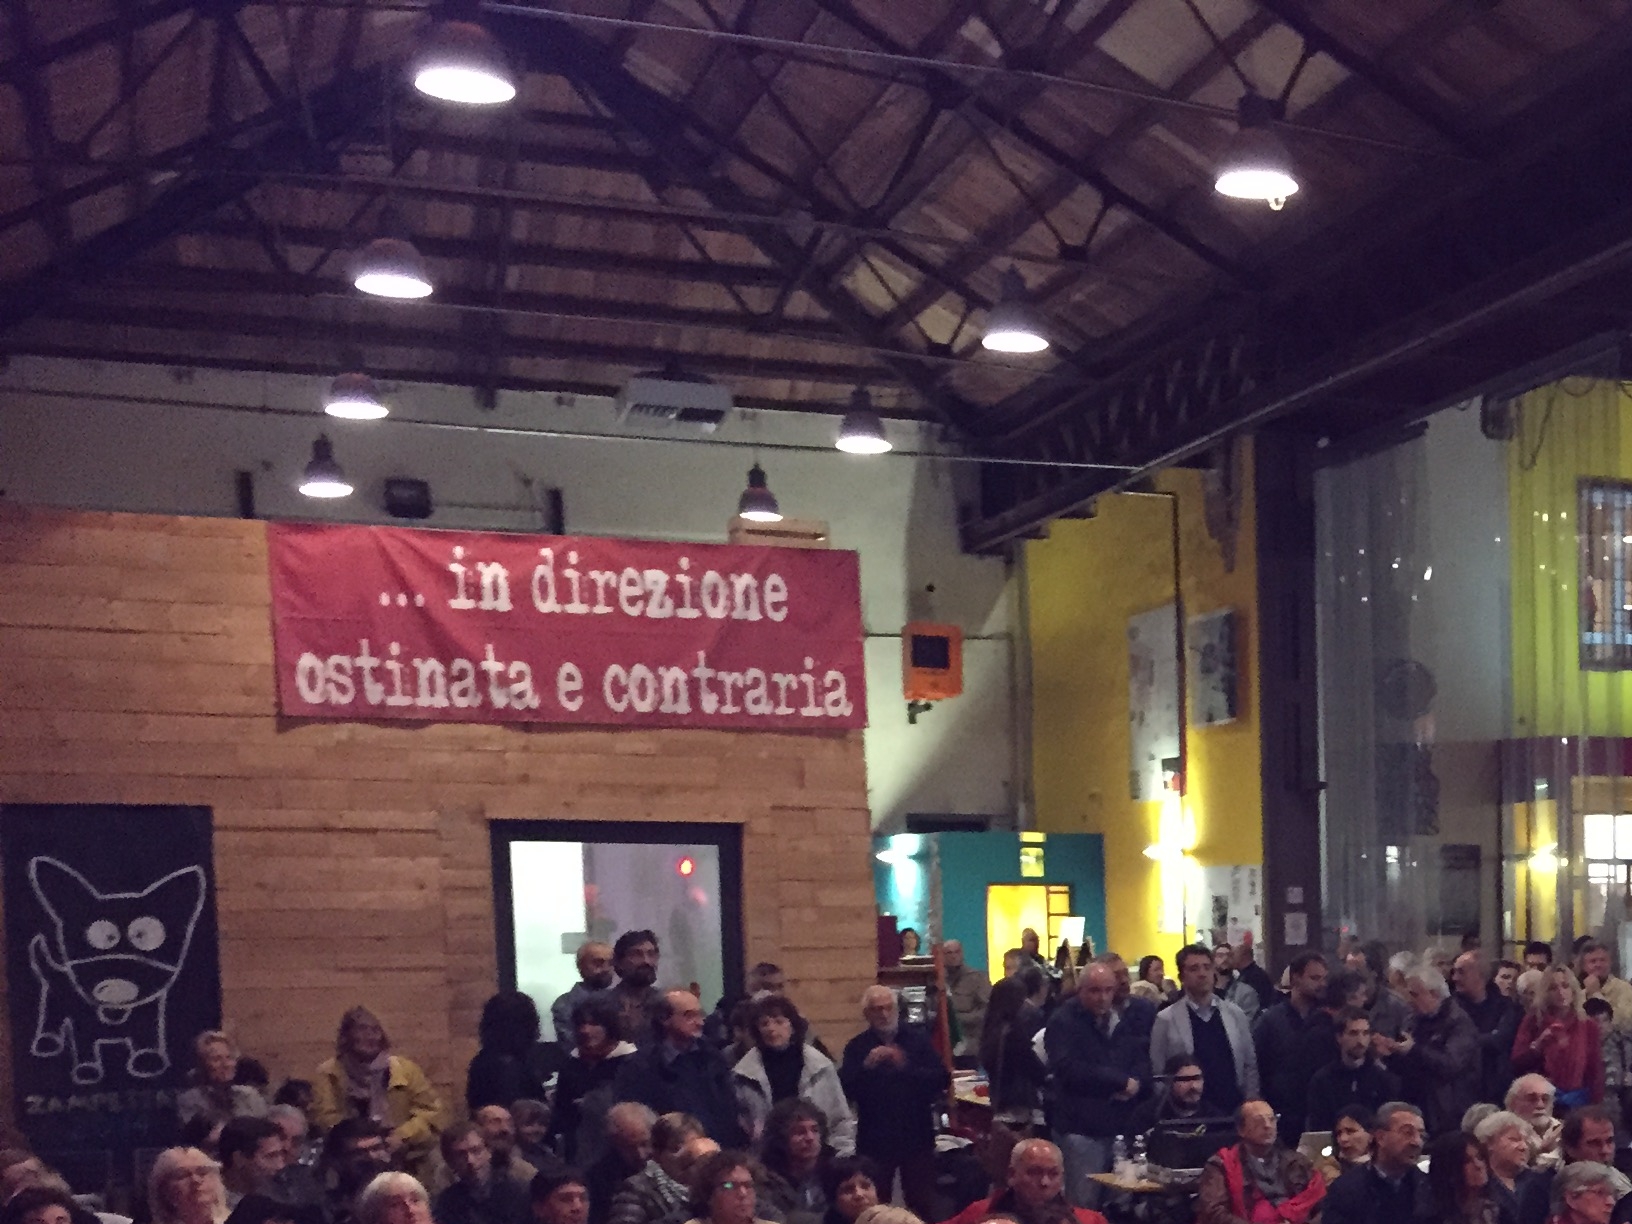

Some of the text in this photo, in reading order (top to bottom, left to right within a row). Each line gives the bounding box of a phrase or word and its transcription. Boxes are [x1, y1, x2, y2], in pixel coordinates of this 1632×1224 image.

[447, 545, 514, 612] in
[531, 547, 789, 622] direzione
[295, 638, 854, 718] ostinata e contraria
